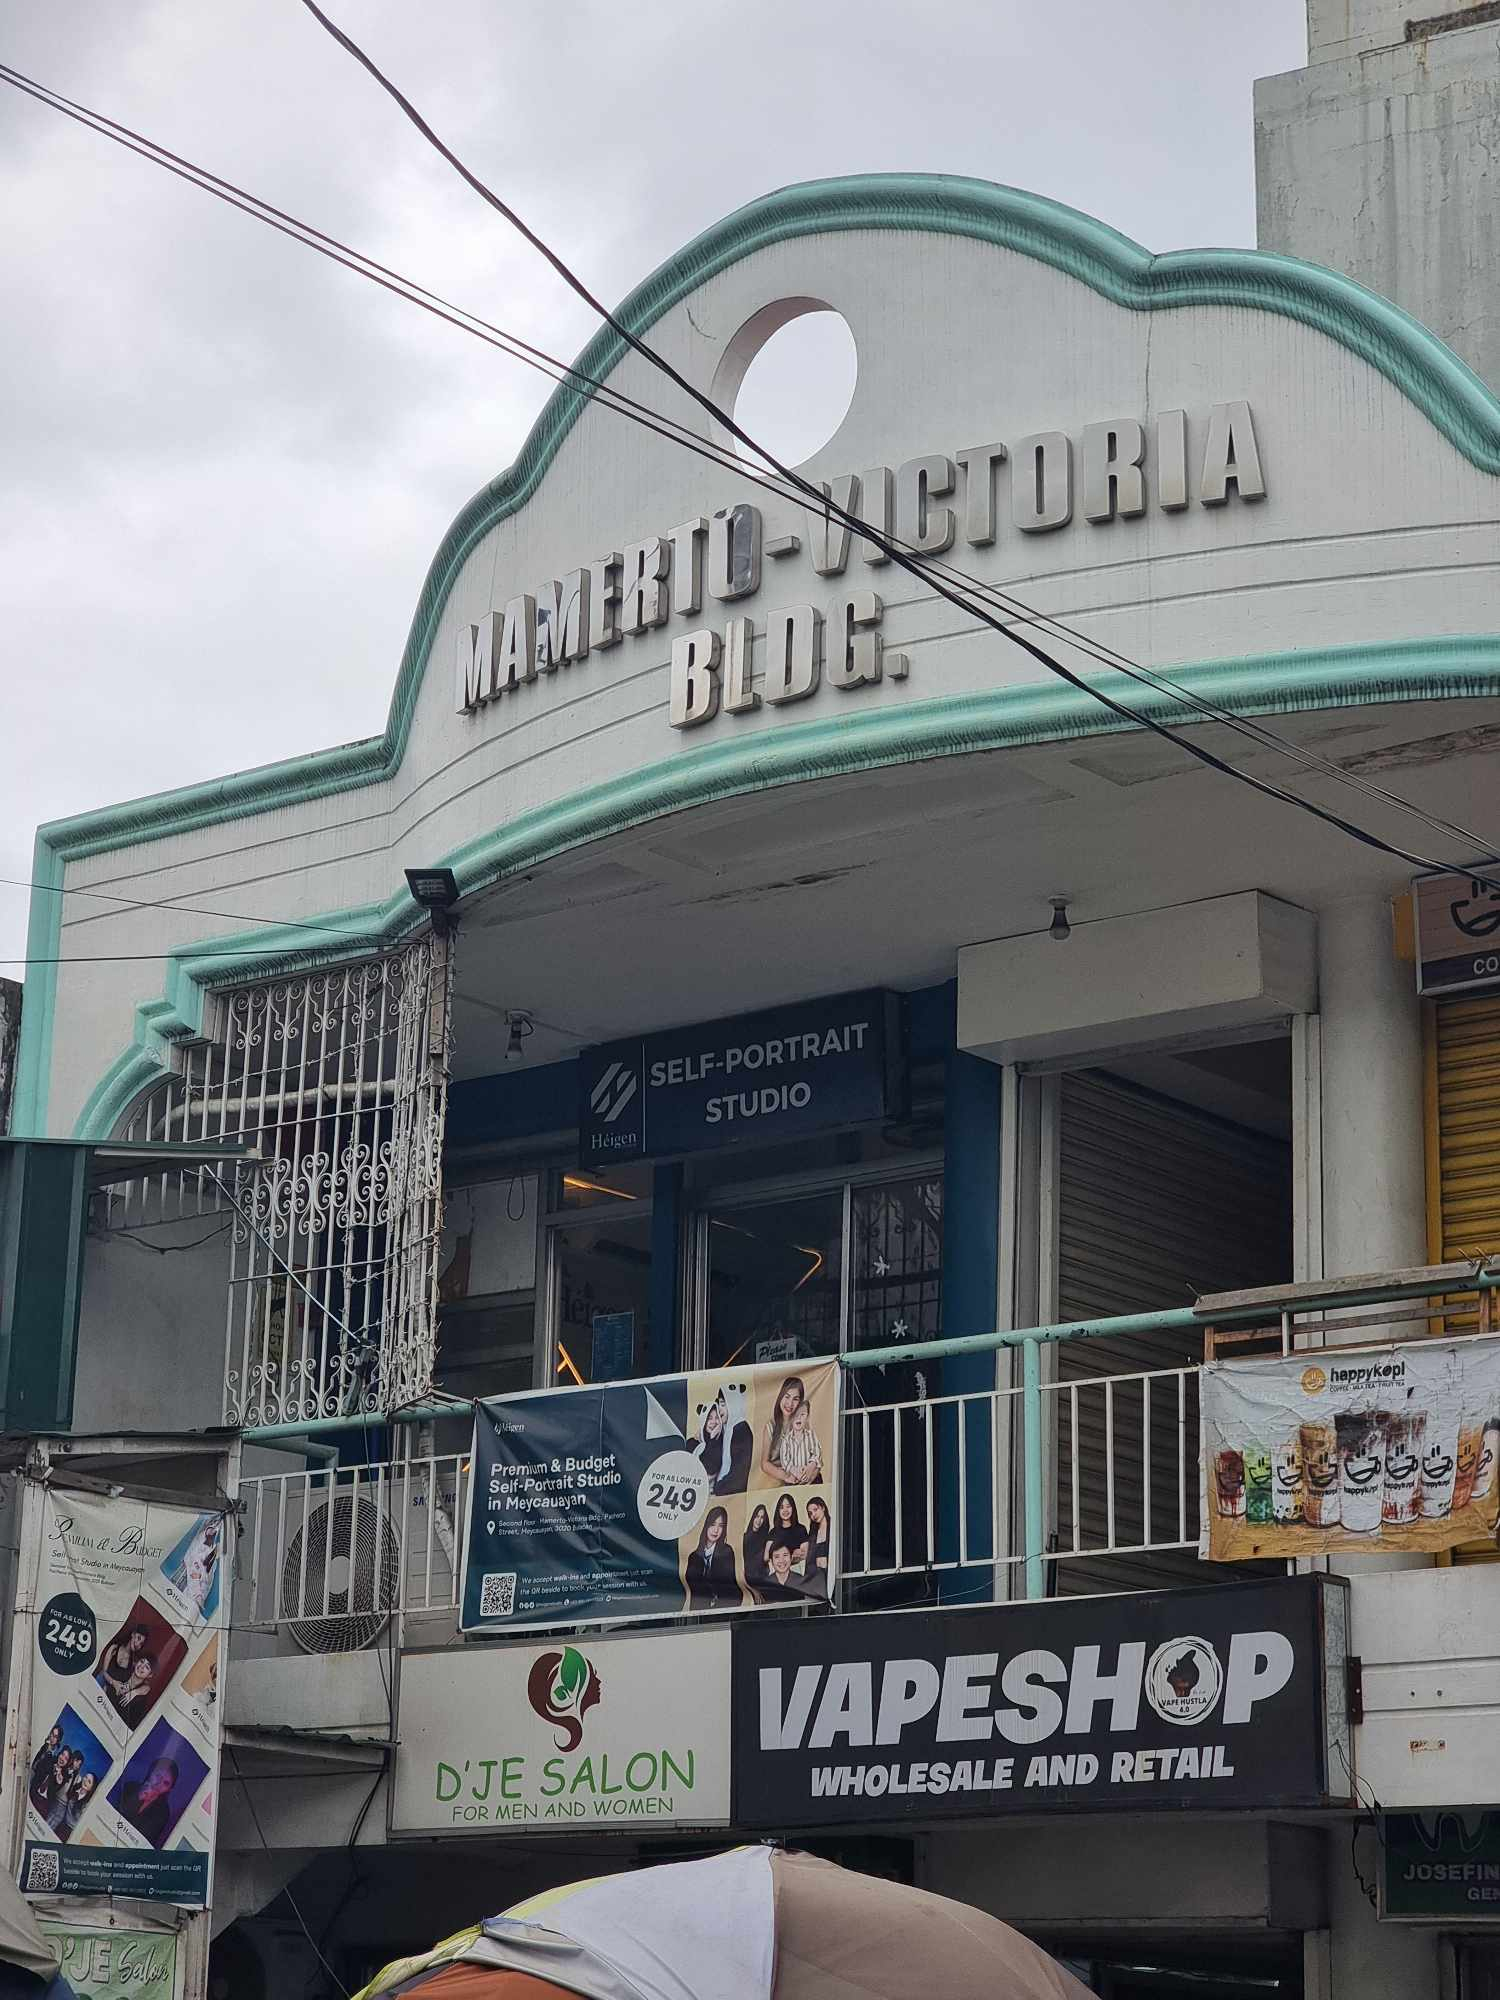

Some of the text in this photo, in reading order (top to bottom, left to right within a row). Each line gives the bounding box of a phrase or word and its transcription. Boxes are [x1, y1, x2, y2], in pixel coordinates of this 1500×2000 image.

[669, 590, 909, 729] BLDG.
[649, 1022, 868, 1088] SELF-PORTRAIT
[705, 1081, 811, 1124] STUDIO
[490, 1453, 616, 1477] Premium & Budget
[489, 1471, 622, 1494] Self-Portrait Studio
[676, 1476, 691, 1484] LOW
[487, 1493, 587, 1513] in Meycauayan
[646, 1483, 697, 1512] 249
[658, 1511, 678, 1520] ONLY
[50, 1608, 63, 1618] FOR
[62, 1613, 73, 1622] AS
[73, 1616, 88, 1627] LOW
[45, 1619, 92, 1653] 249
[54, 1646, 74, 1660] ONLY
[436, 1749, 694, 1801] D'JE SALON
[811, 1745, 1234, 1798] WHOLESALE AND RETAIL
[452, 1797, 673, 1822] FOR MEN AND WOMEN
[118, 1940, 169, 1985] Salon
